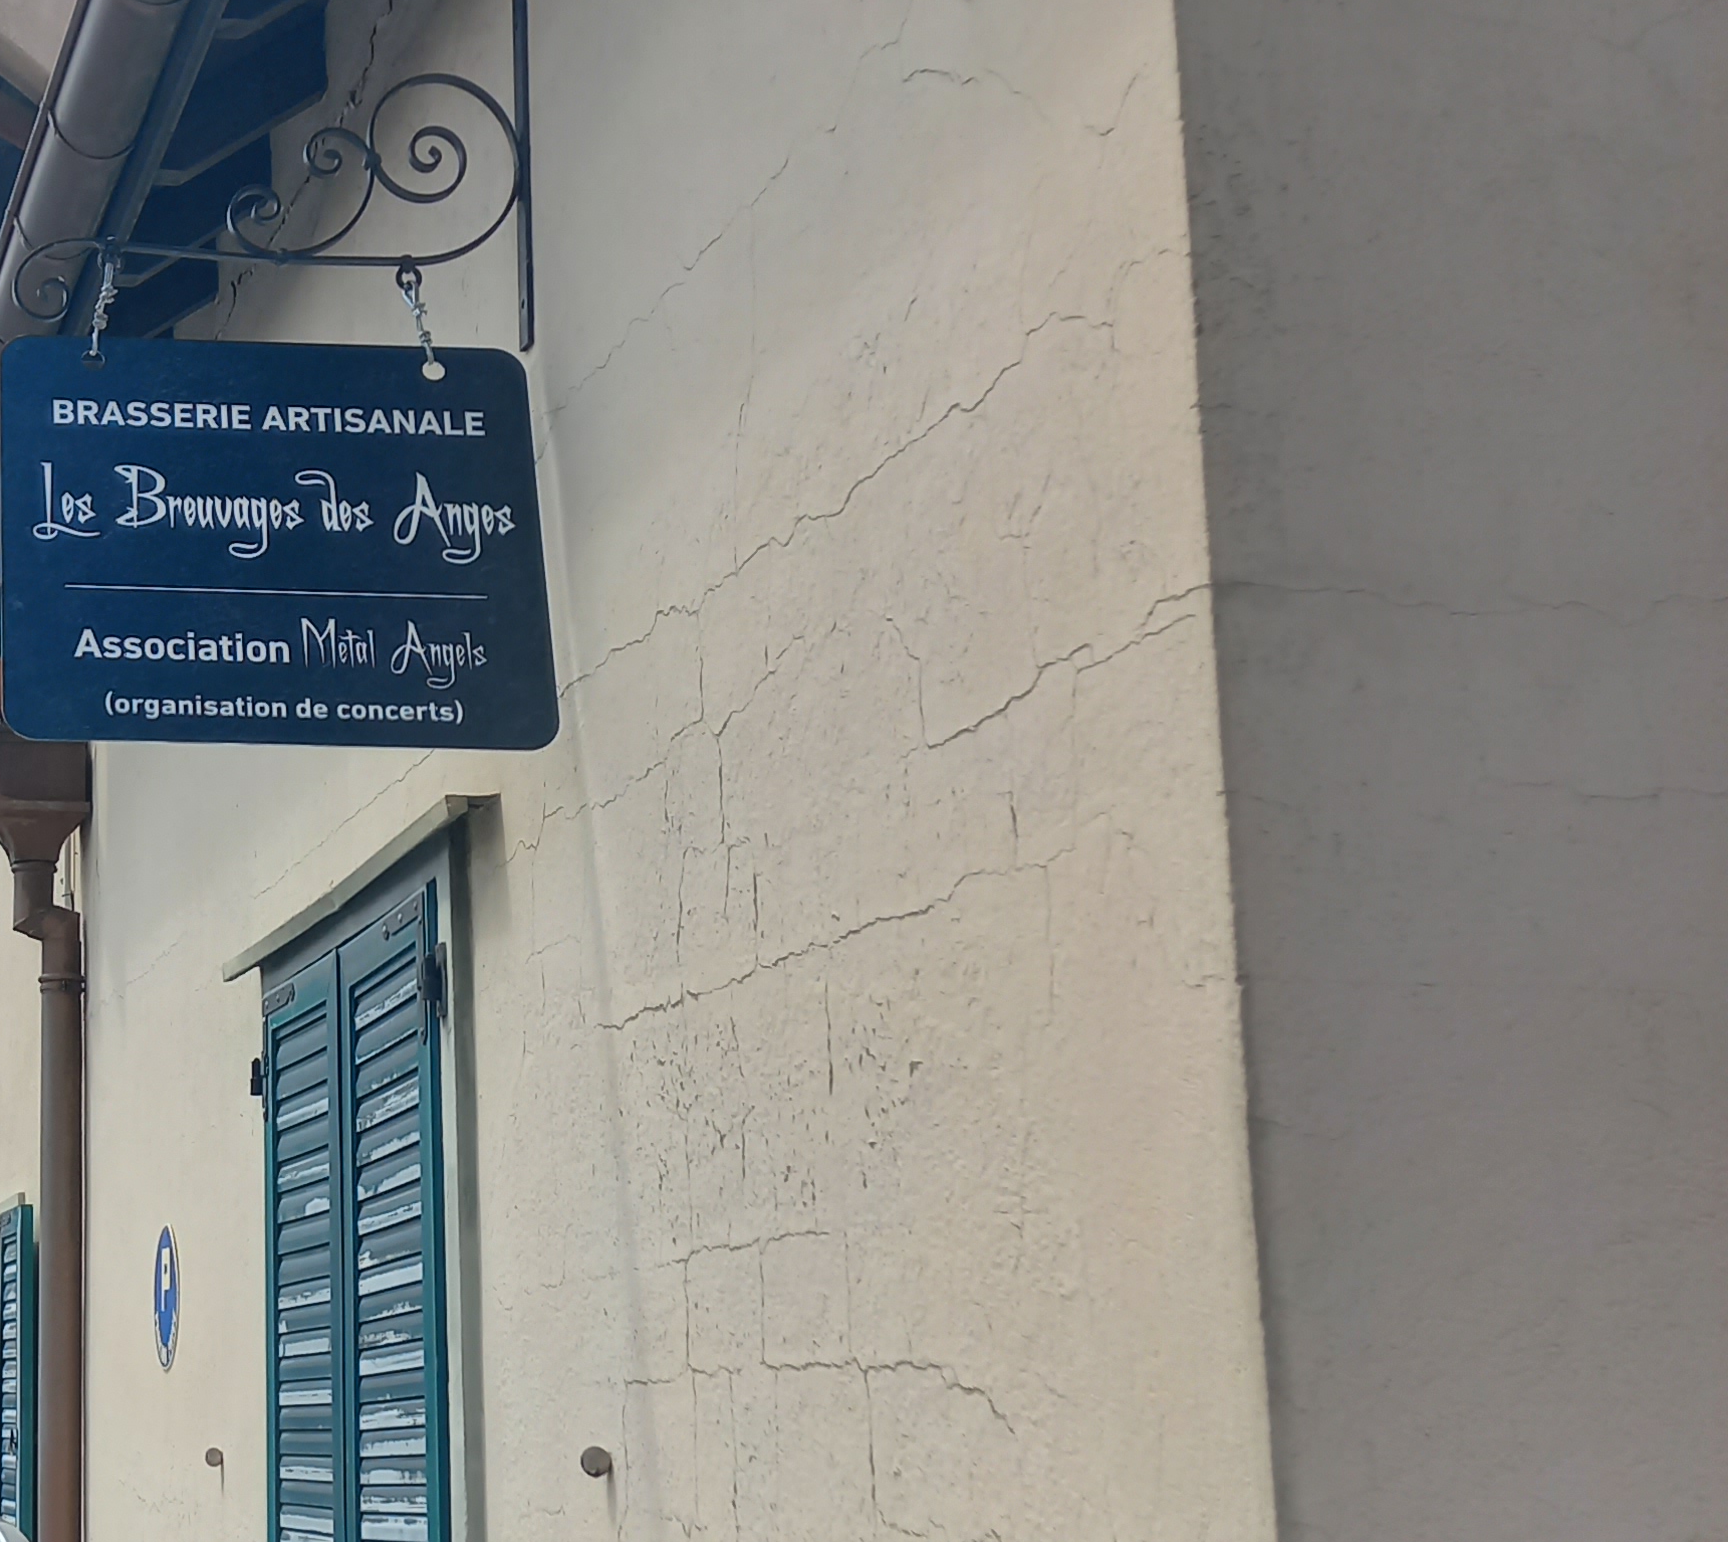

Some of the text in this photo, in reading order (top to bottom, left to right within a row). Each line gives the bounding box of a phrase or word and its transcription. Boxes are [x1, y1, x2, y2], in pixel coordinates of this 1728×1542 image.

[52, 398, 487, 437] BRASSERIE ARTISANALE
[32, 461, 516, 564] Les Breuvages des Anges
[74, 627, 290, 663] Association
[390, 620, 488, 689] Angels
[104, 691, 464, 724] (organisation de concerts)
